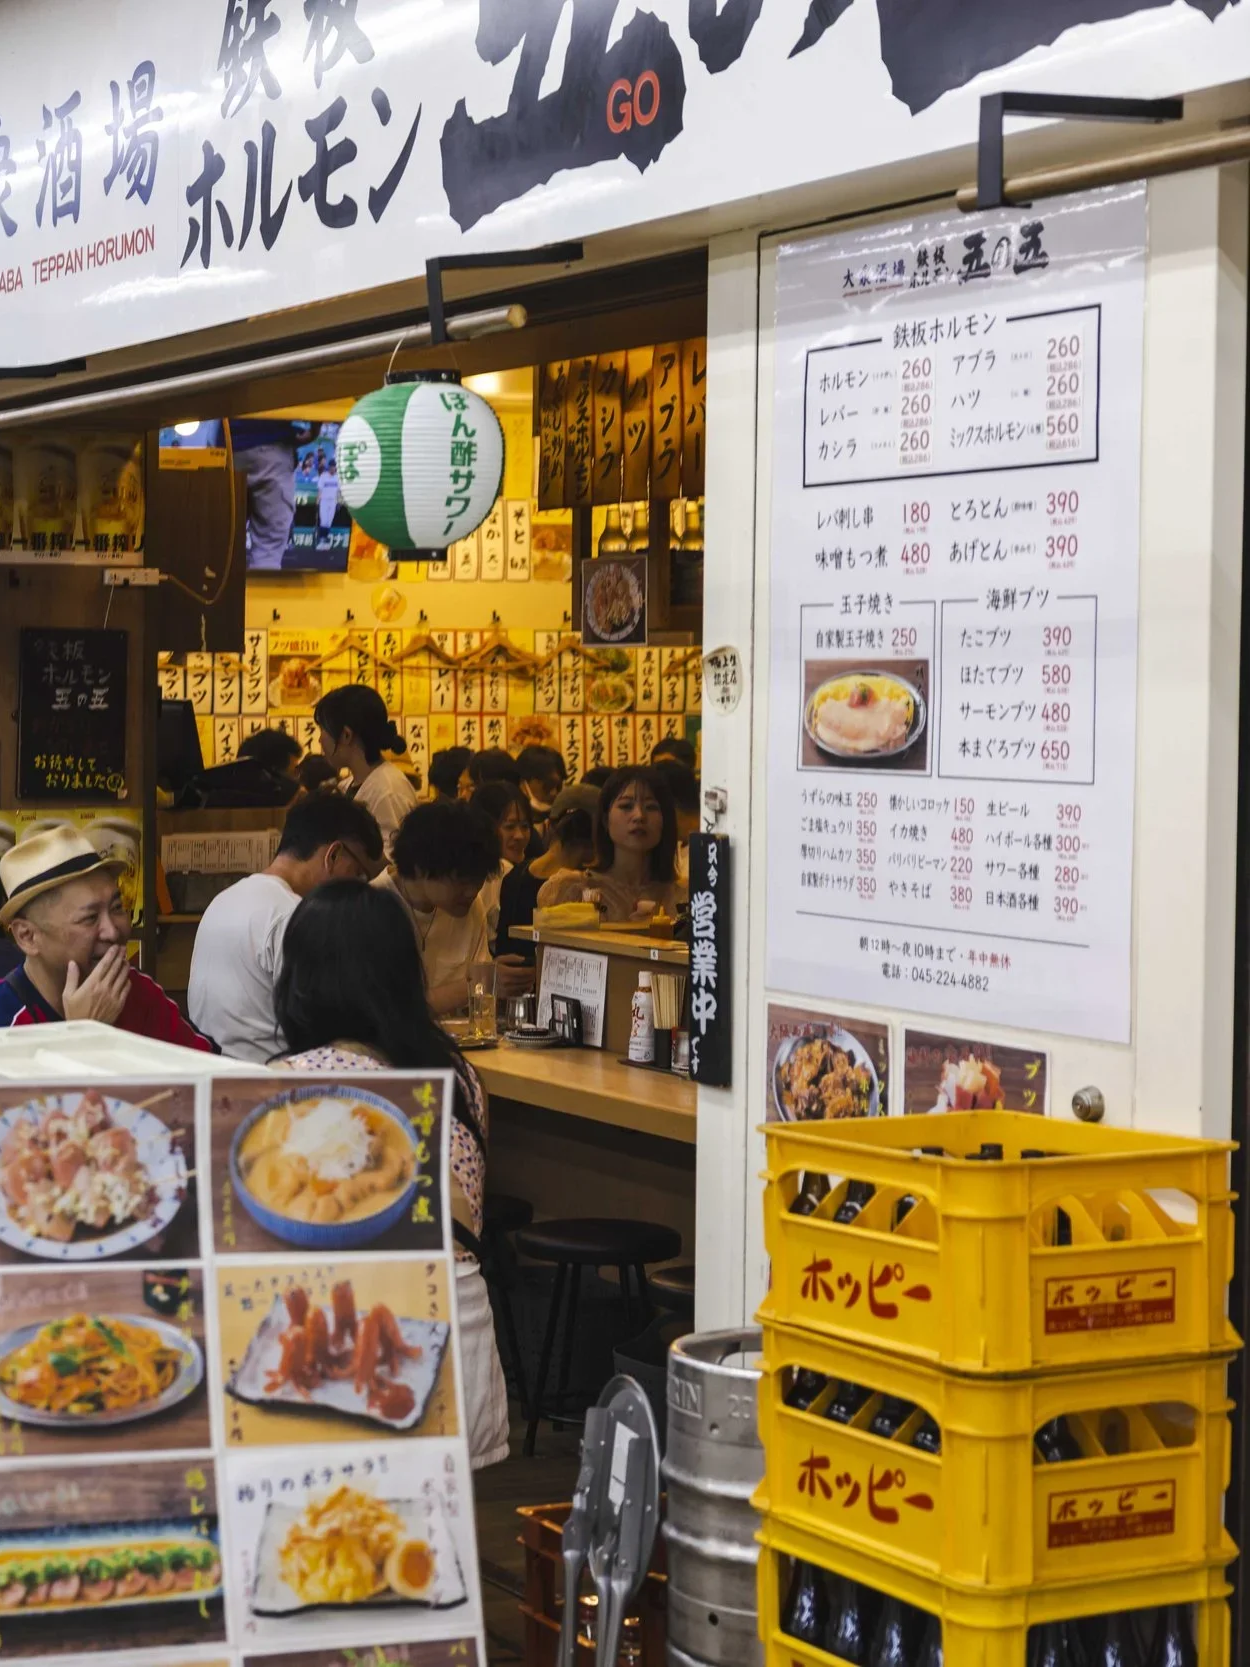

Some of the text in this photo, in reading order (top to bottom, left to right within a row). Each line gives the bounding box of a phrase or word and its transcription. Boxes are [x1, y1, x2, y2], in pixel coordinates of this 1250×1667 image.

[607, 70, 661, 134] GO
[180, 87, 422, 269] ホルモン
[32, 247, 84, 285] TEPPAN
[86, 225, 155, 275] HORUMON
[893, 312, 997, 350] 鉄板ホルモン
[953, 335, 1080, 375] アブラ 260
[819, 357, 931, 393] ホルモン 260
[951, 372, 1080, 410] ハツ 260
[598, 361, 618, 480] カシラ
[628, 376, 648, 456] ハツ
[658, 352, 676, 480] アブラ
[820, 393, 931, 426] レバー 260
[1046, 413, 1079, 437] 560
[819, 430, 930, 461] カシラ 260
[817, 501, 930, 531] レバ刺し串 180
[951, 490, 1079, 521] とろとん 390
[815, 543, 930, 571] 味噌もつ煮 480
[950, 534, 1078, 563] あげとん 390
[839, 592, 894, 615] 玉子焼き
[986, 585, 1050, 612] 海鮮ブツ
[816, 627, 917, 649] 自家製玉子焼き 250
[960, 625, 1072, 649] たこブツ 390
[960, 663, 1071, 685] ほたてブツ 580
[959, 700, 1070, 723] サーモンブツ 480
[958, 737, 1070, 761] 本まぐろブツ 650
[856, 792, 878, 808] 250
[953, 797, 975, 815] 150
[986, 800, 1081, 822] 生ビール 390
[856, 820, 877, 837] 350
[890, 823, 974, 844] イカ焼き 480
[985, 830, 1081, 853] ハイボール各種 300
[856, 848, 877, 865] 350
[950, 856, 973, 874] 220
[856, 876, 877, 893] 350
[985, 859, 1080, 884] サワー各種 280
[889, 880, 973, 903] やきそば 380
[985, 890, 1079, 915] 日本酒各種 390
[690, 890, 718, 1035] 営業中
[801, 1250, 932, 1320] ホッピー
[1053, 1275, 1168, 1305] ホッピー
[797, 1446, 935, 1525] ホッピー
[1056, 1488, 1168, 1520] ホッピー
